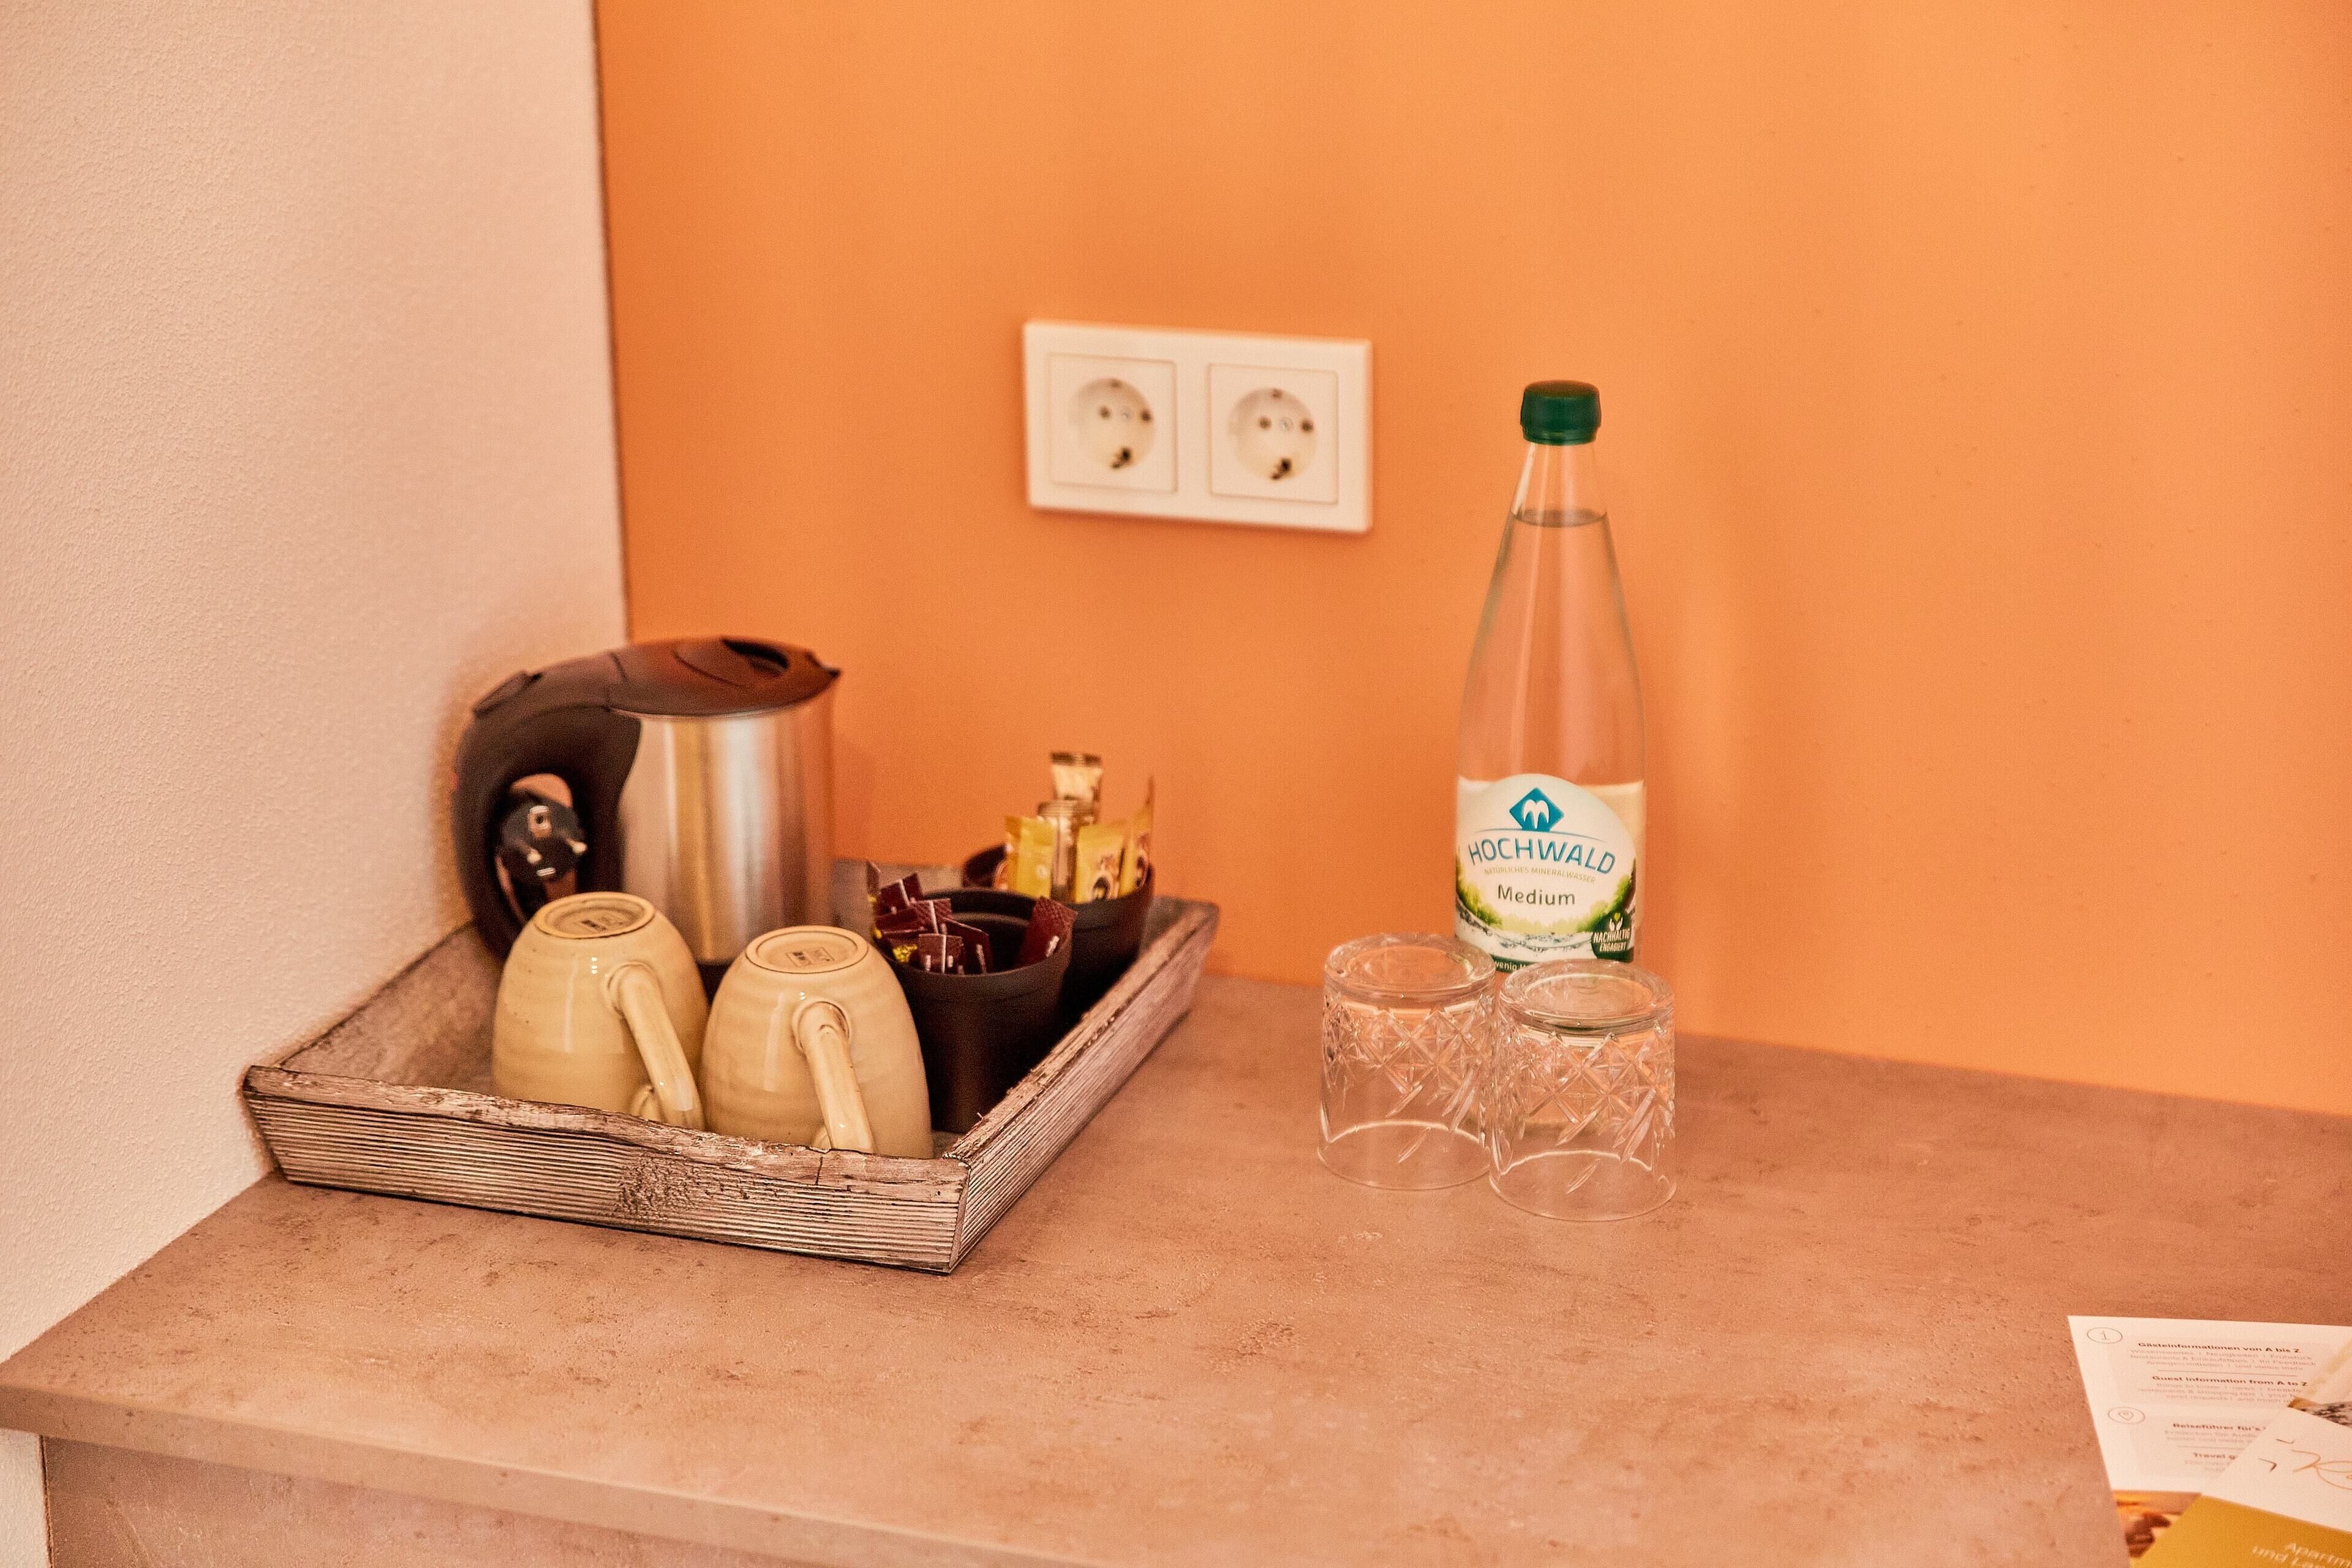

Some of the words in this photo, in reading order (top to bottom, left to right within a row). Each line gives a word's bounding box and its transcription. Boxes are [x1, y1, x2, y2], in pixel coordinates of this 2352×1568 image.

[1468, 837, 1616, 874] HOCHWALD
[1484, 866, 1529, 876] NATÜRLICHES
[1531, 867, 1596, 884] MINERALWASSER
[1498, 884, 1576, 906] Medium
[1593, 927, 1630, 944] NACHHALTIG
[1599, 941, 1627, 952] ENGAGIERT
[2138, 1342, 2240, 1351] Gästeinformationen
